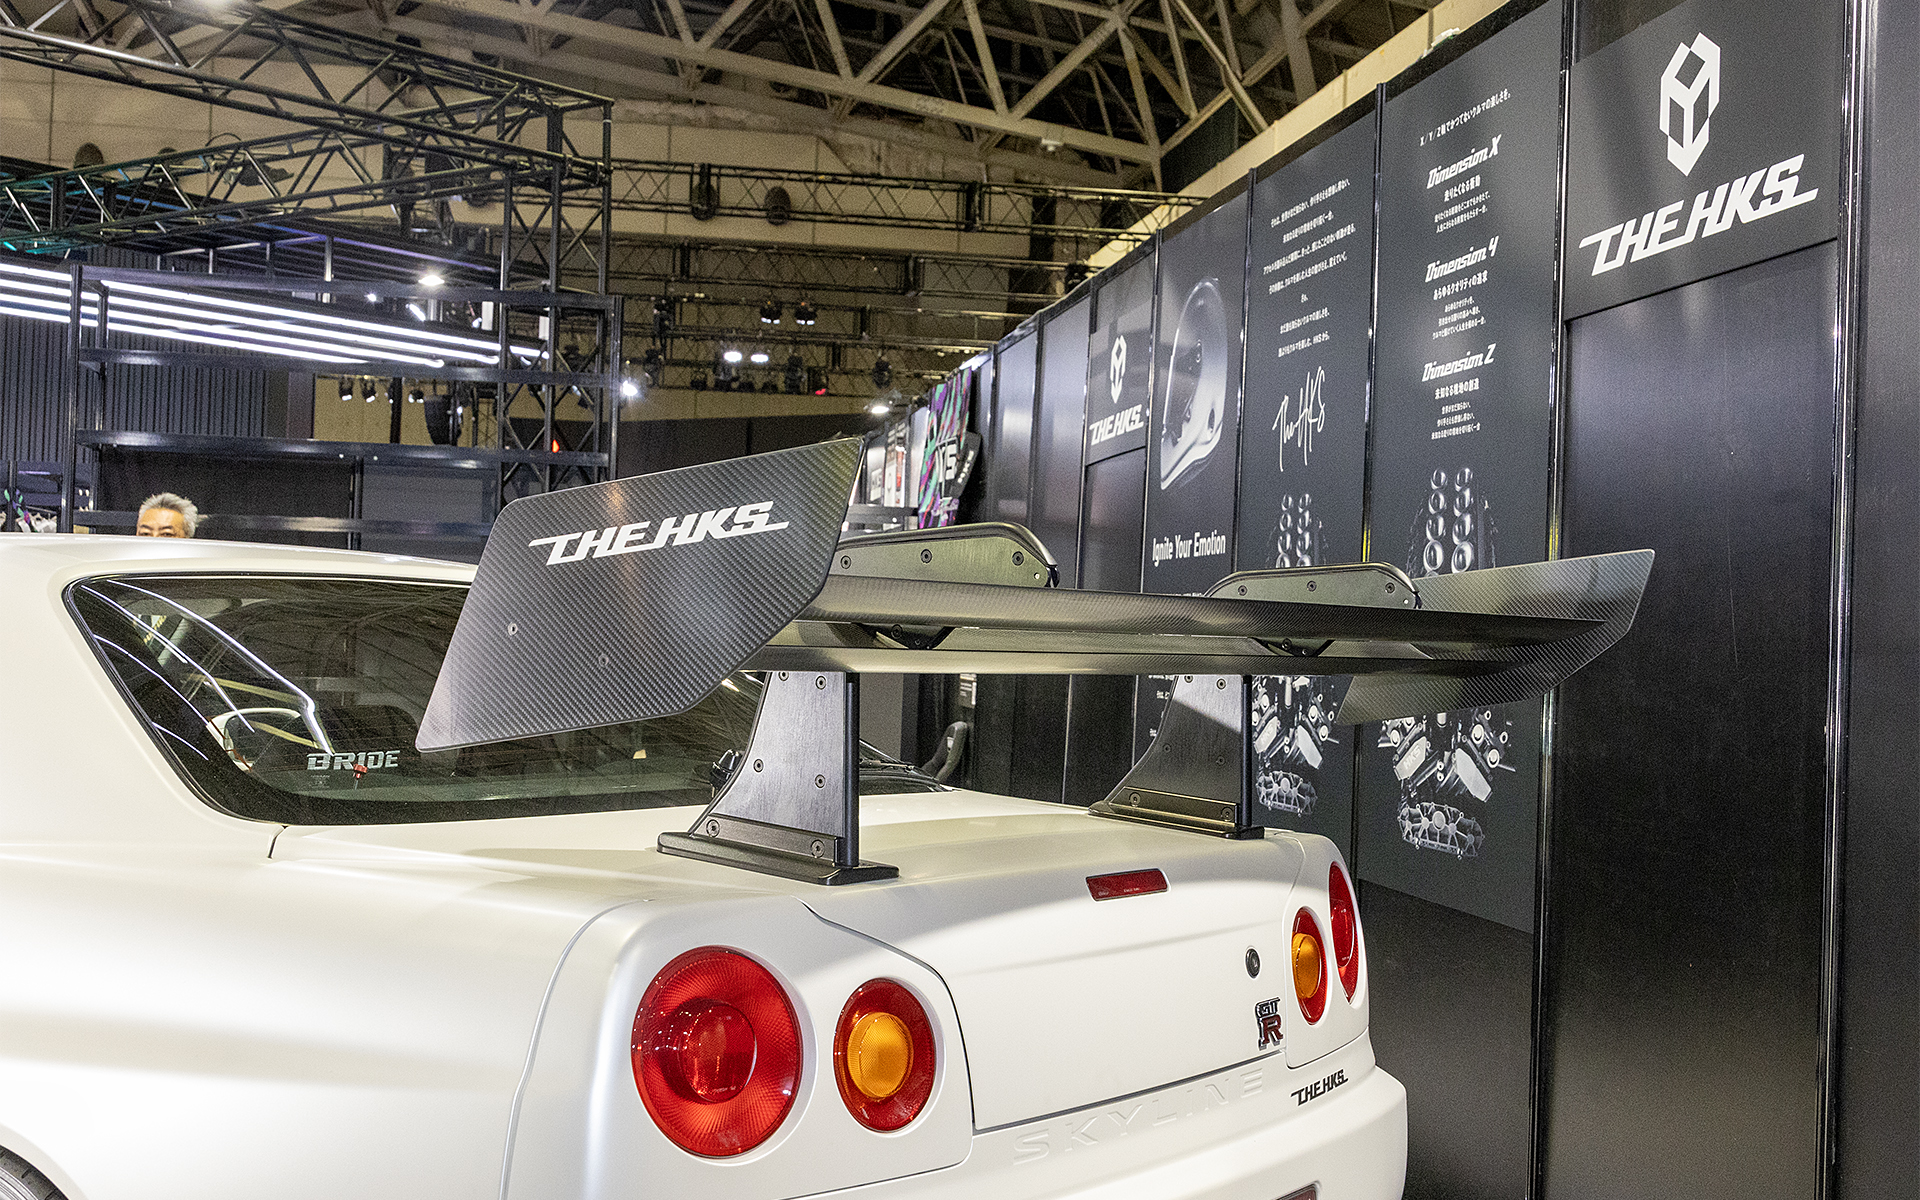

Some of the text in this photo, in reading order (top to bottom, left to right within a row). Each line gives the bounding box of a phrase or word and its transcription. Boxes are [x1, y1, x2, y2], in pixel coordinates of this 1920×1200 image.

[1426, 134, 1502, 189] Dimension X
[1425, 246, 1487, 282] Dimension
[1422, 343, 1497, 382] Dimension Z
[1152, 529, 1226, 567] Ignite Your Emotion
[306, 750, 401, 770] BRIDE
[1013, 1067, 1263, 1166] SKYLINE
